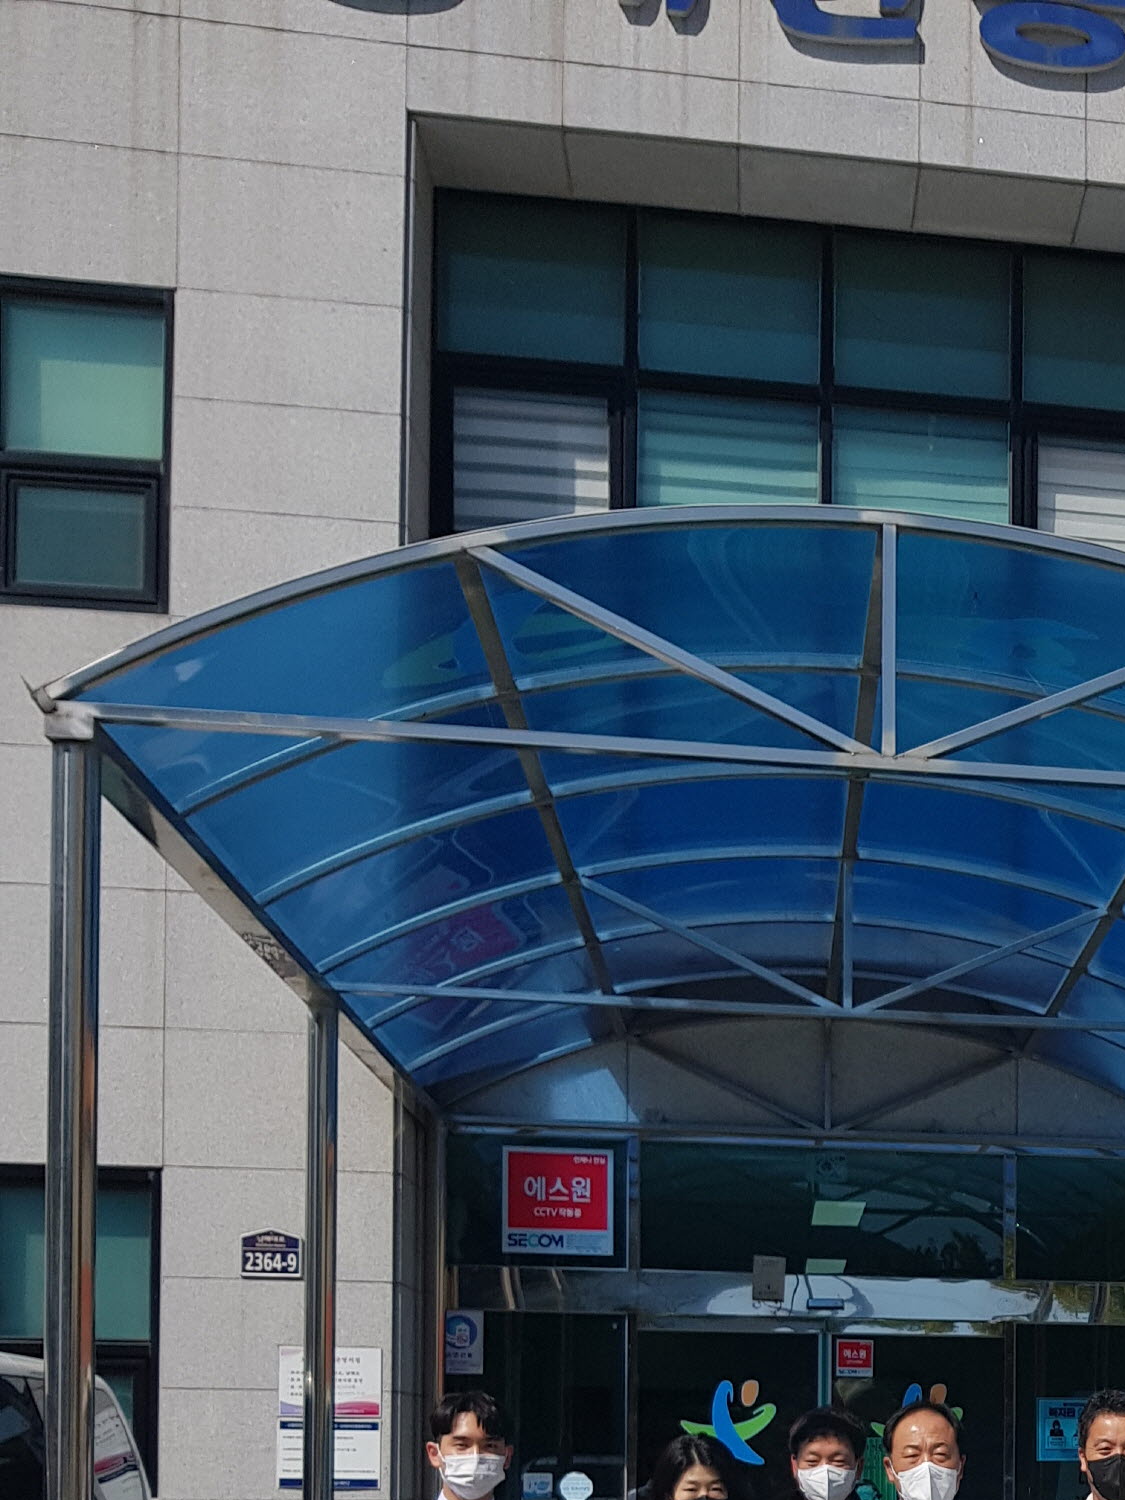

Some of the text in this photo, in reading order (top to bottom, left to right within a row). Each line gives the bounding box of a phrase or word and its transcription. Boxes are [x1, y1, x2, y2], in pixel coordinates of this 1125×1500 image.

[523, 1175, 591, 1204] 에스원
[533, 1206, 558, 1217] CCTV
[507, 1233, 565, 1248] SECOM
[244, 1251, 298, 1272] 2364-9
